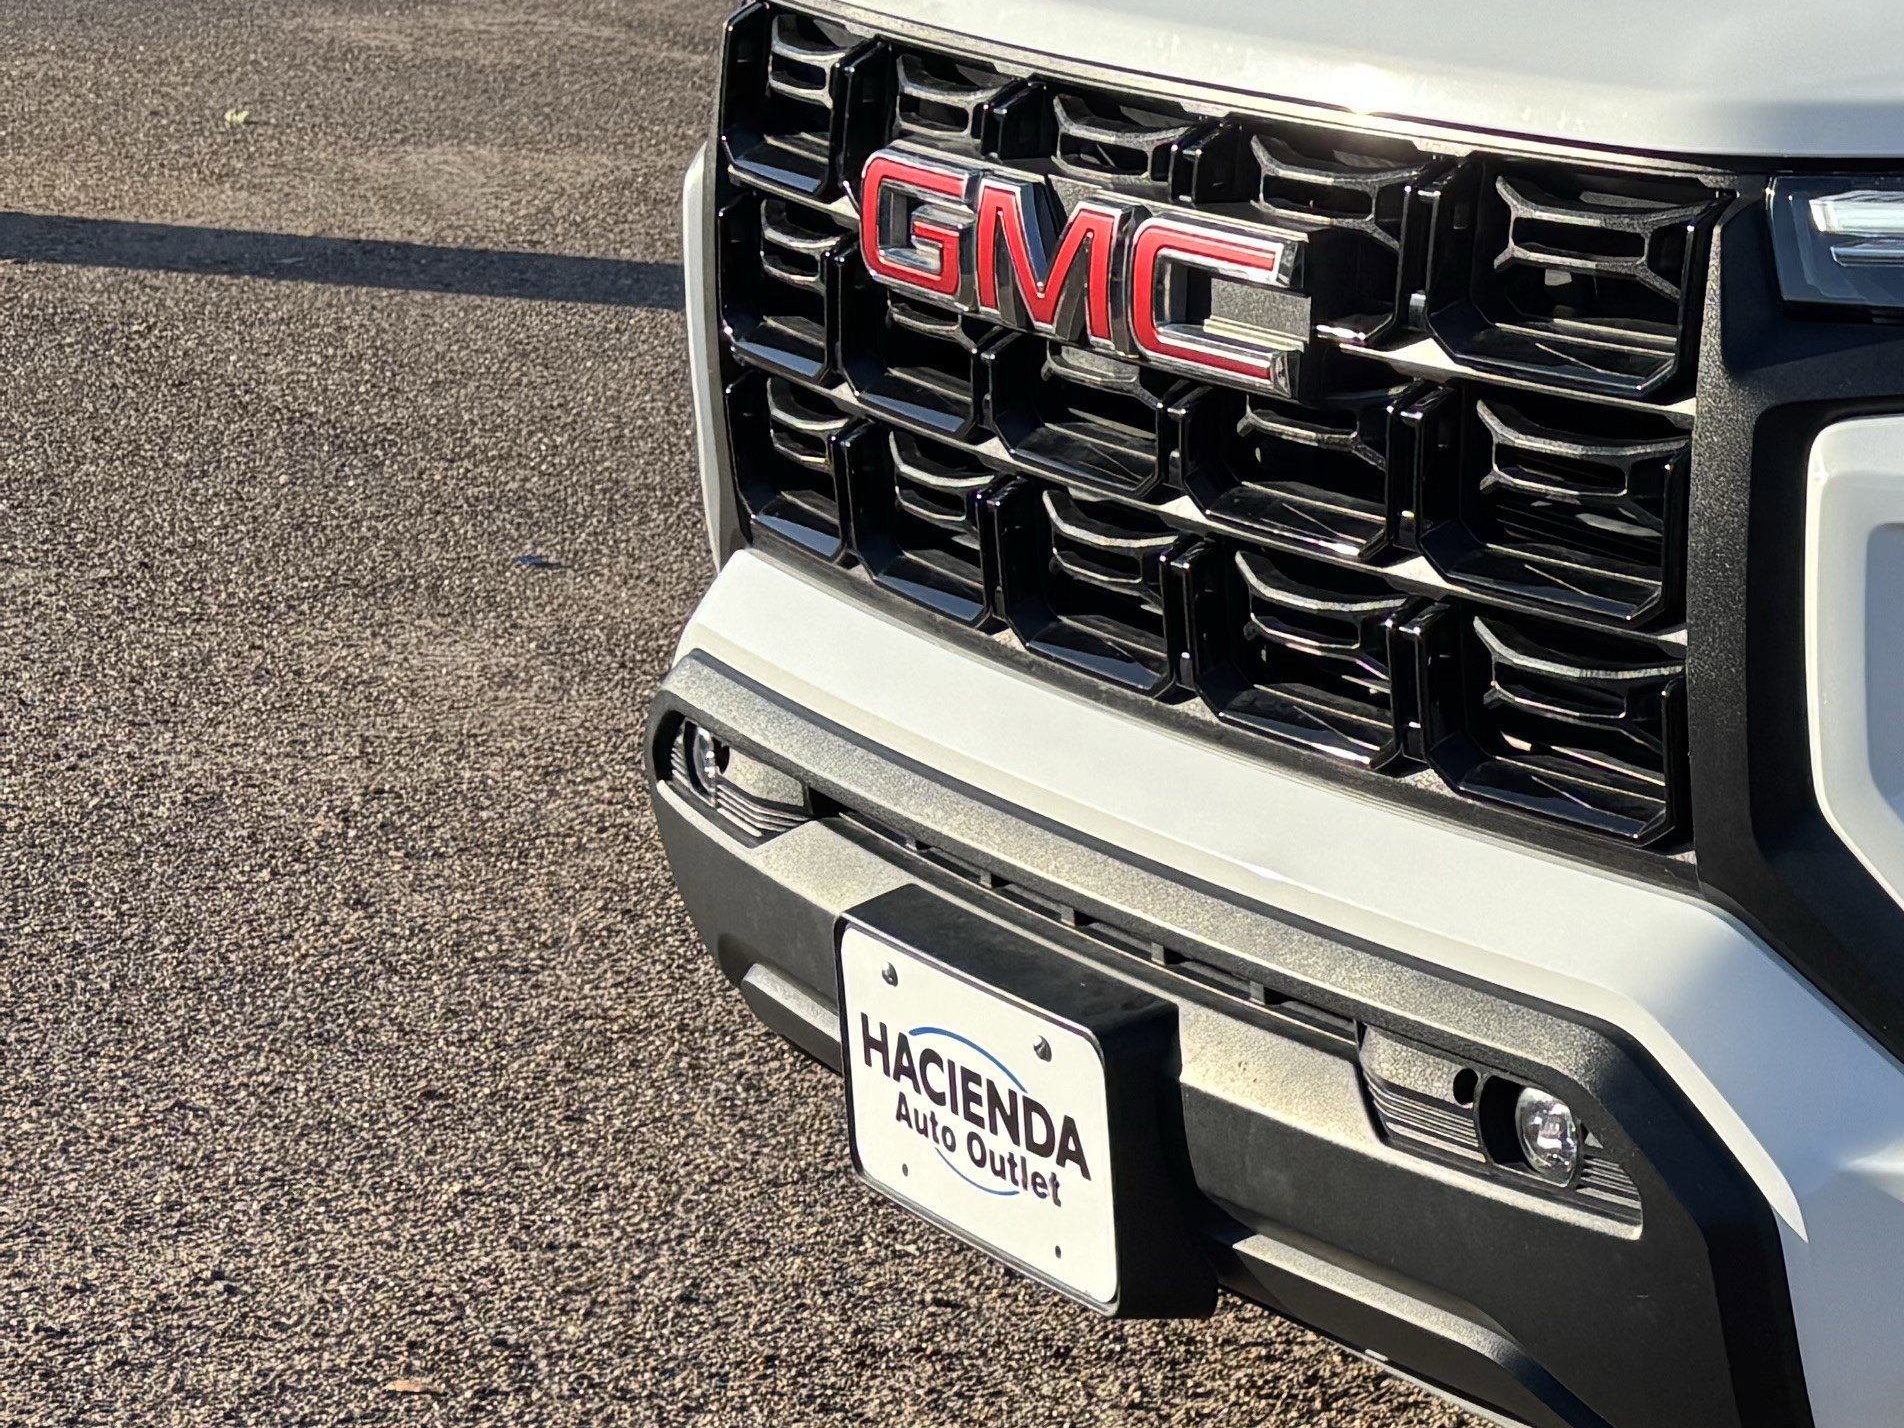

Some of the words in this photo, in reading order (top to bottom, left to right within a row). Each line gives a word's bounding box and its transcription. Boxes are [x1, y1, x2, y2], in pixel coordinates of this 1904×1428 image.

[859, 147, 1305, 398] GMC
[859, 1011, 1092, 1182] HACIENDA
[895, 1090, 957, 1153] Auto
[966, 1132, 1062, 1208] Outlet
